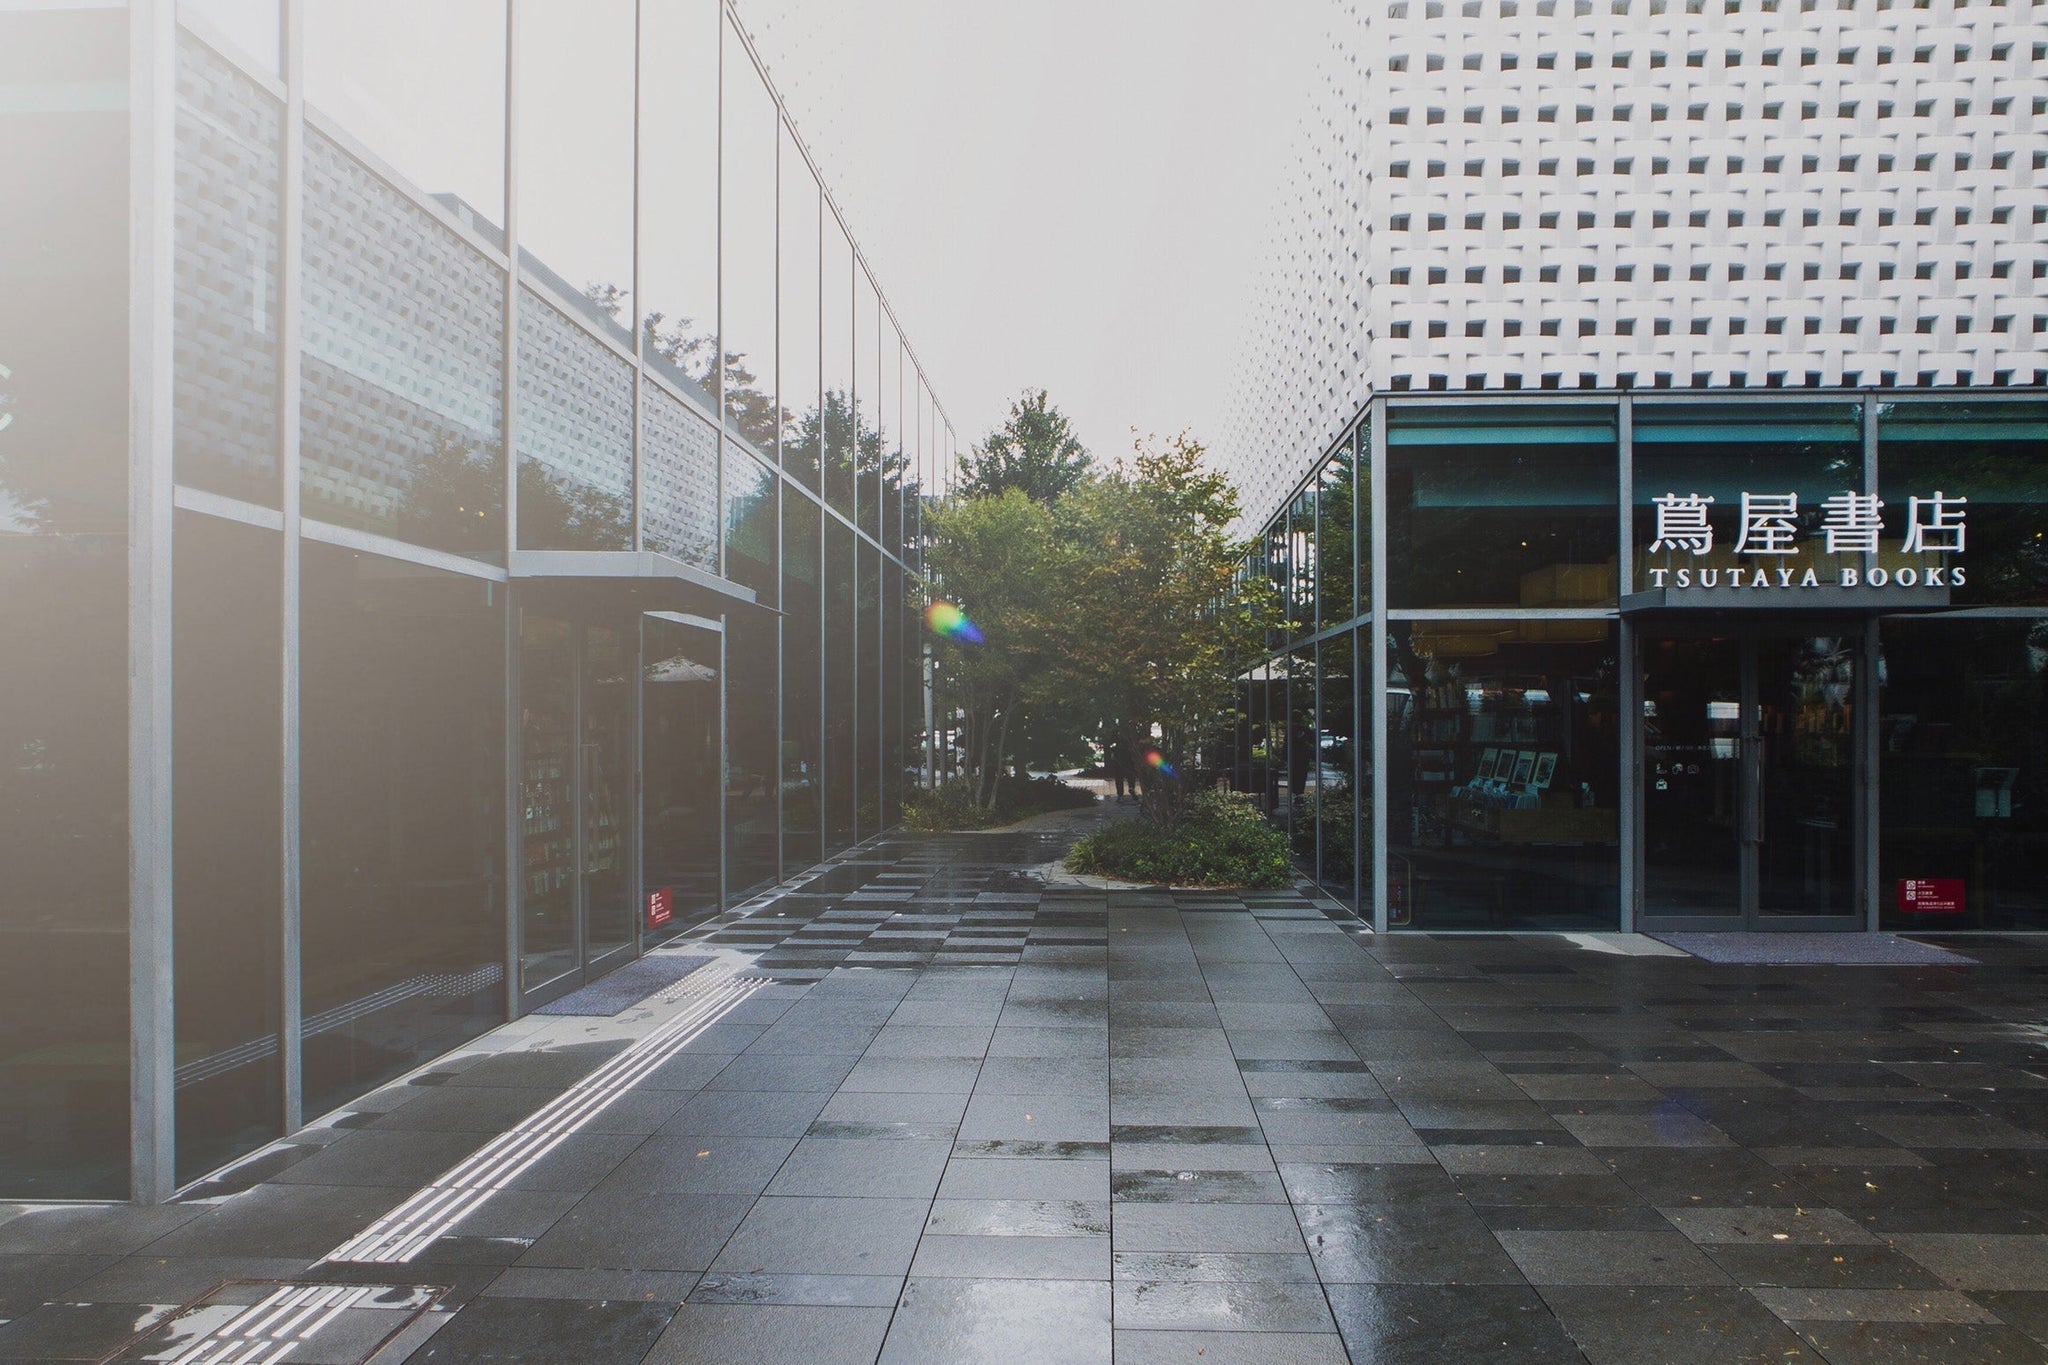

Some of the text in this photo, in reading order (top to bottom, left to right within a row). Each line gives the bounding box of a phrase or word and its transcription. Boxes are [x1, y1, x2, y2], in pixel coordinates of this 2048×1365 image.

[1648, 491, 1967, 555] 蔦屋書店
[1649, 567, 1967, 587] TSUTAYA BOOKS
